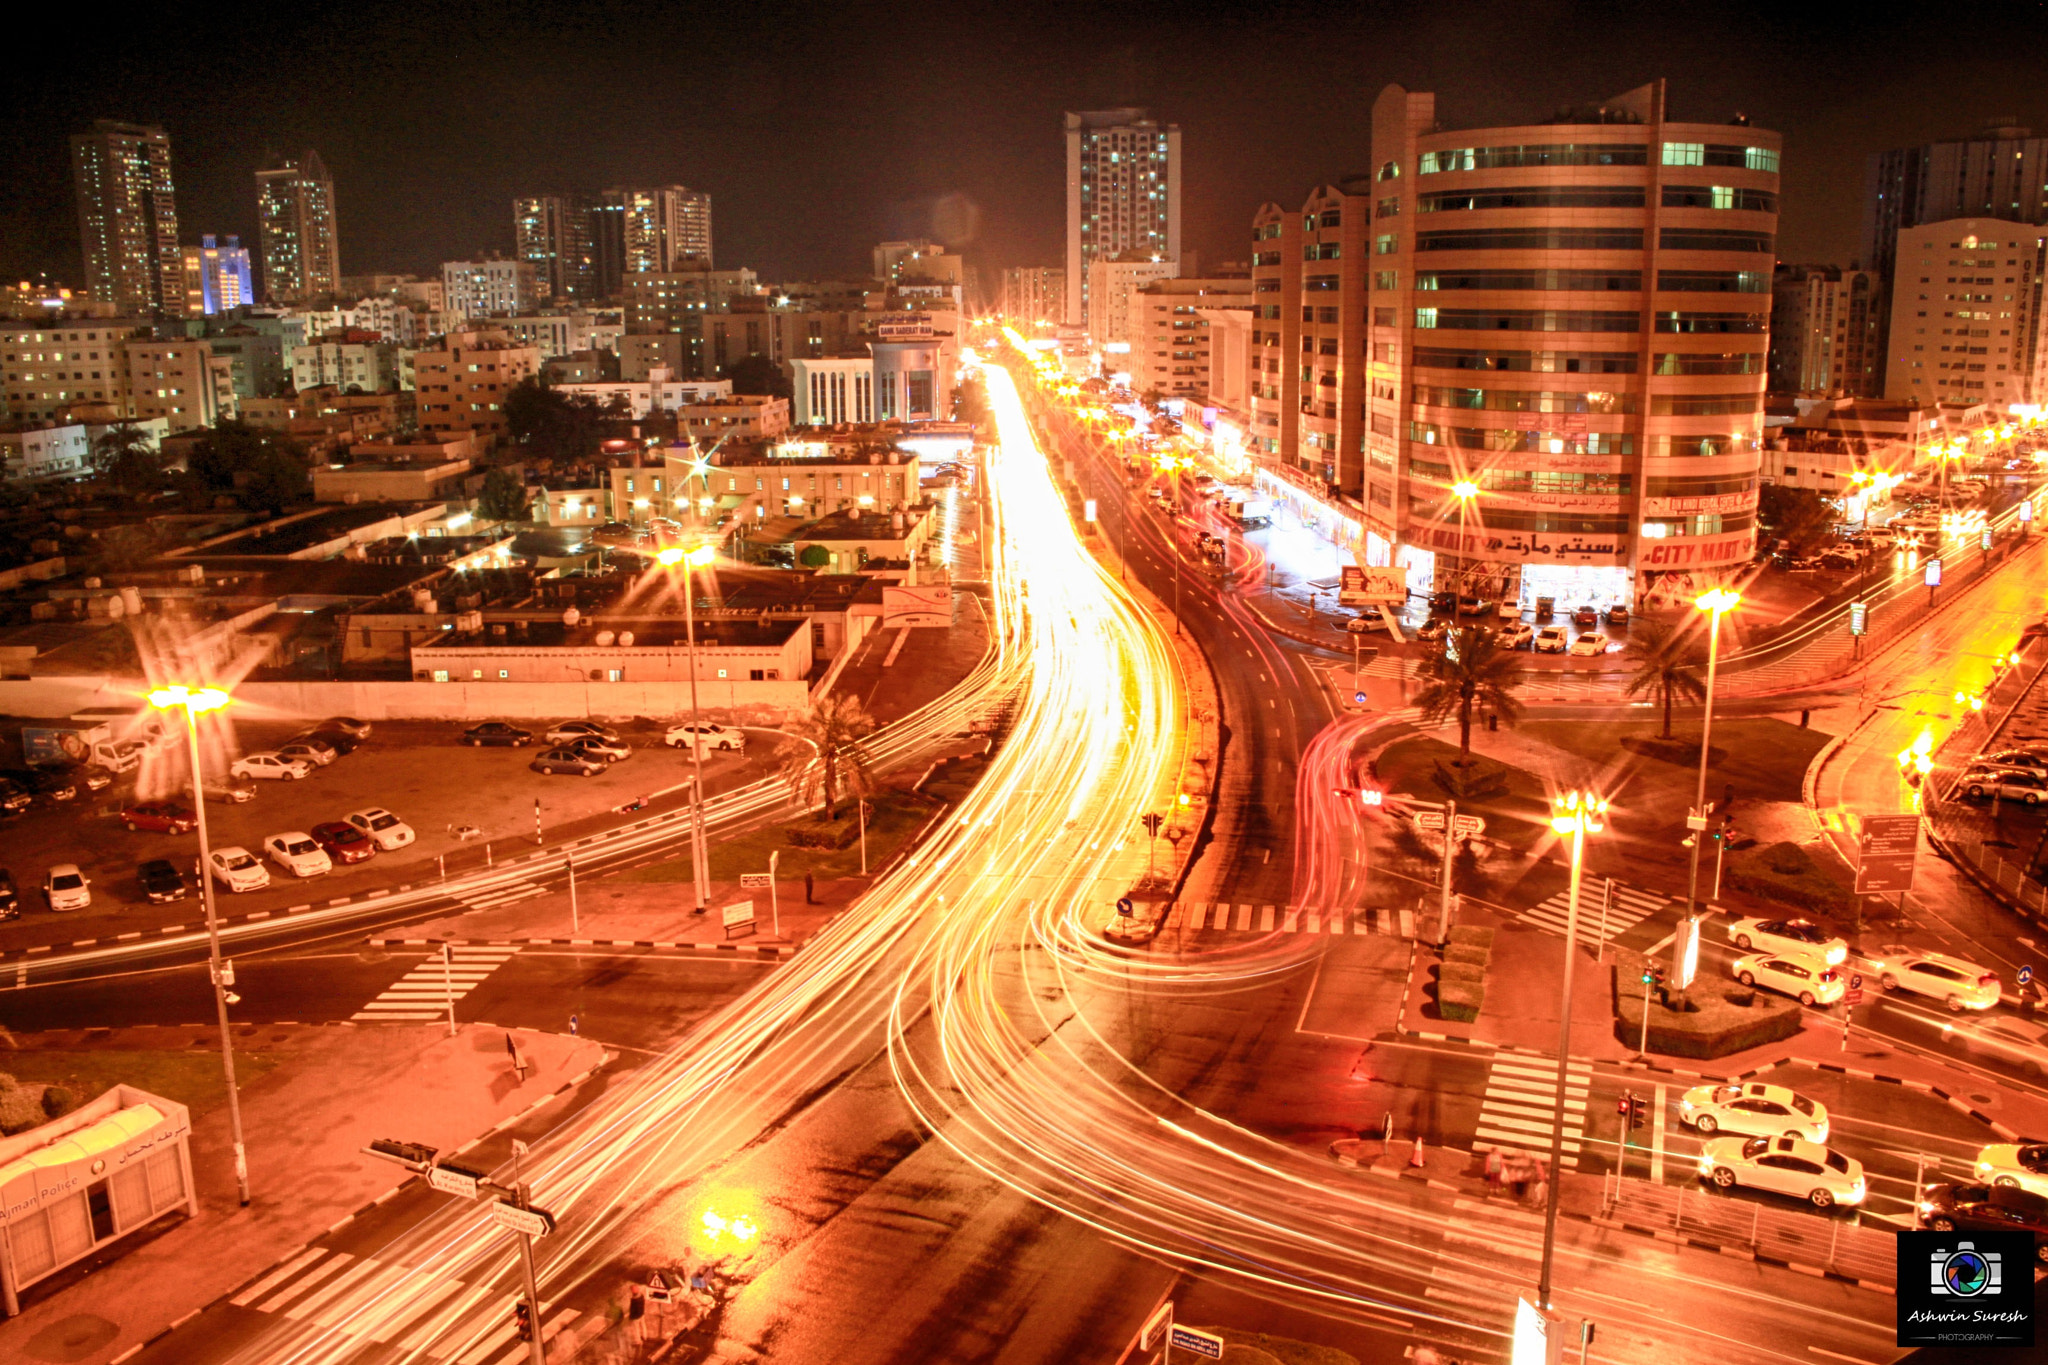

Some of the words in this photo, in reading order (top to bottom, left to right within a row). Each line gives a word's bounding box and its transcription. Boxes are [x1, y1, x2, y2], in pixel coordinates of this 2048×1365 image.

[881, 326, 895, 335] BANK
[1505, 533, 1551, 556] مارت
[1555, 537, 1614, 559] سيتي
[1650, 544, 1695, 565] CITY
[1700, 540, 1740, 562] MART
[0, 1195, 38, 1220] Ajman
[41, 1176, 78, 1200] Police
